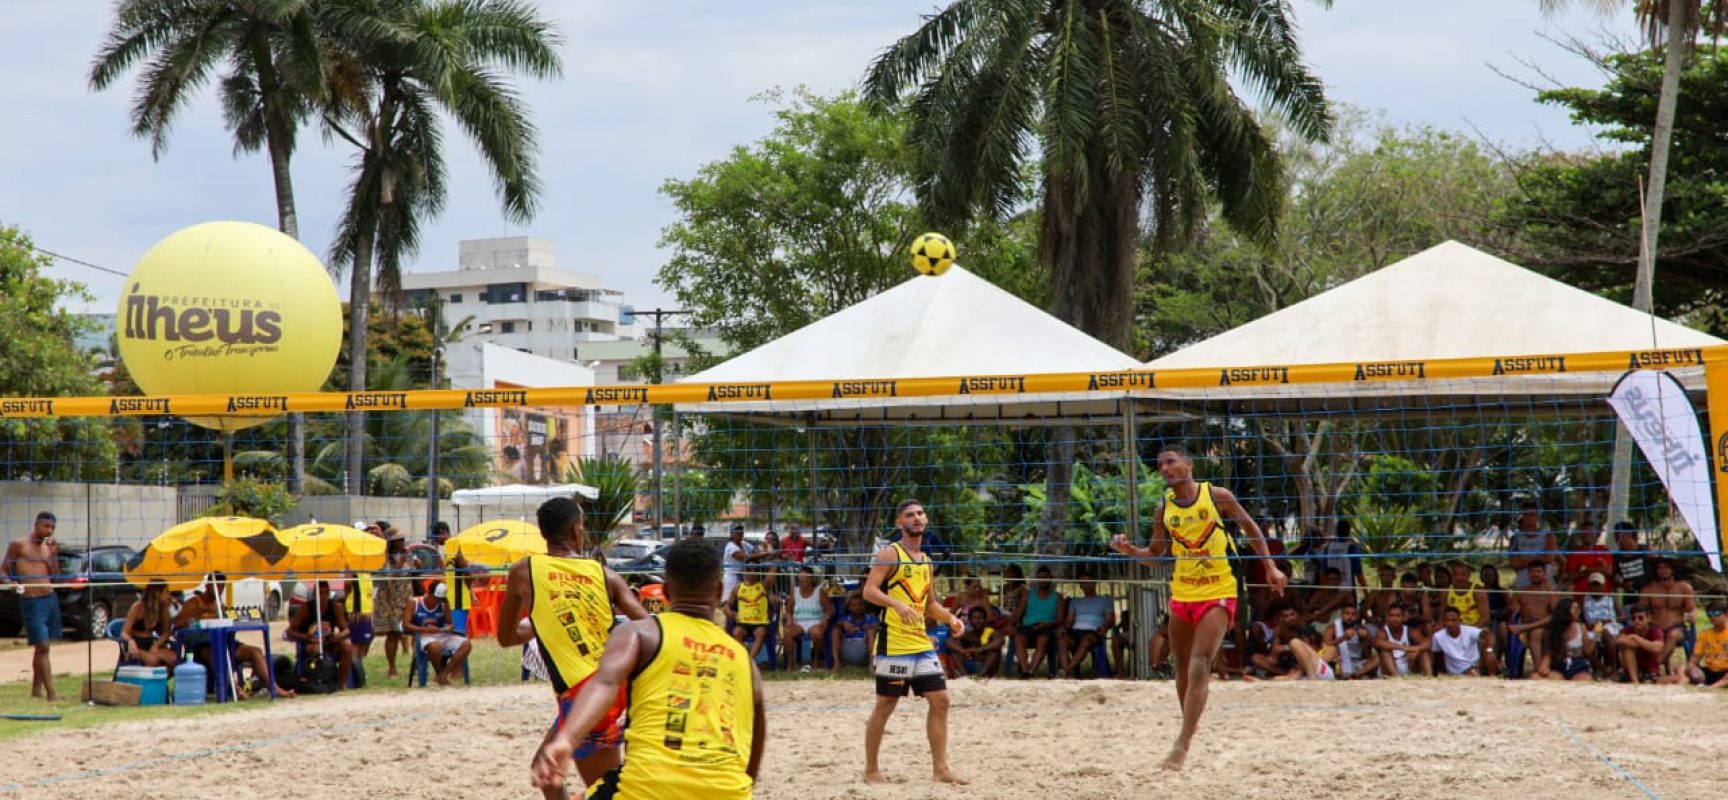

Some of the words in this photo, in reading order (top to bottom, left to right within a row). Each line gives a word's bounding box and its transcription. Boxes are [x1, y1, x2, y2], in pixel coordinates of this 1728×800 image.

[162, 295, 262, 308] PREFEITURA
[1493, 357, 1566, 375] ASSFUTI
[1629, 349, 1705, 369] ASSFUTI
[1219, 367, 1288, 386] ASSFUTI
[1354, 362, 1425, 381] ASSFUTI
[832, 381, 897, 398] ASSFUTI
[959, 377, 1025, 394] ASSFUTI
[1088, 373, 1156, 391] ASSFUTI
[345, 393, 407, 409] ASSFUTI
[464, 391, 527, 407] ASSFUTI
[585, 388, 648, 404] ASSFUTI
[707, 384, 771, 401] ASSFUTI
[0, 401, 53, 415] SSFUTI
[110, 398, 170, 414] ASSFUTI
[227, 396, 288, 412] ASSFUTI
